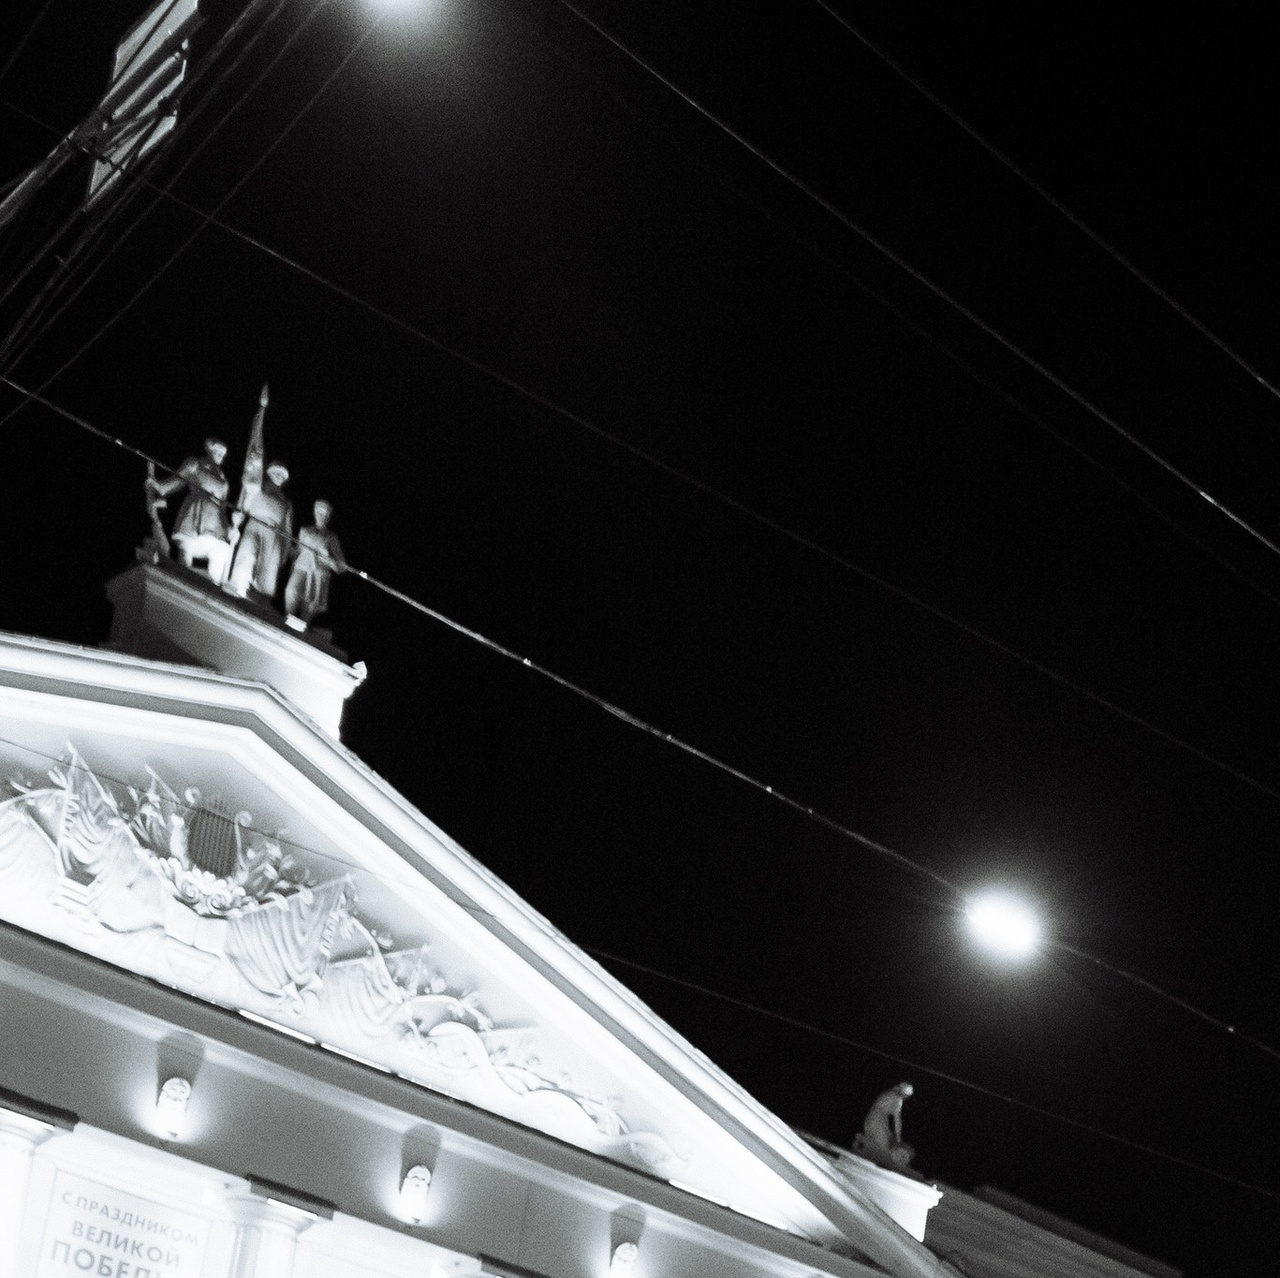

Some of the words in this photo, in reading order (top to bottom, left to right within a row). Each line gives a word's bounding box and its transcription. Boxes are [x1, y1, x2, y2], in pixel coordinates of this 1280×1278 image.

[62, 1191, 72, 1205] С
[75, 1196, 199, 1246] ПРАЗДНИКОМ
[71, 1220, 180, 1269] ВЕЛИКОЙ
